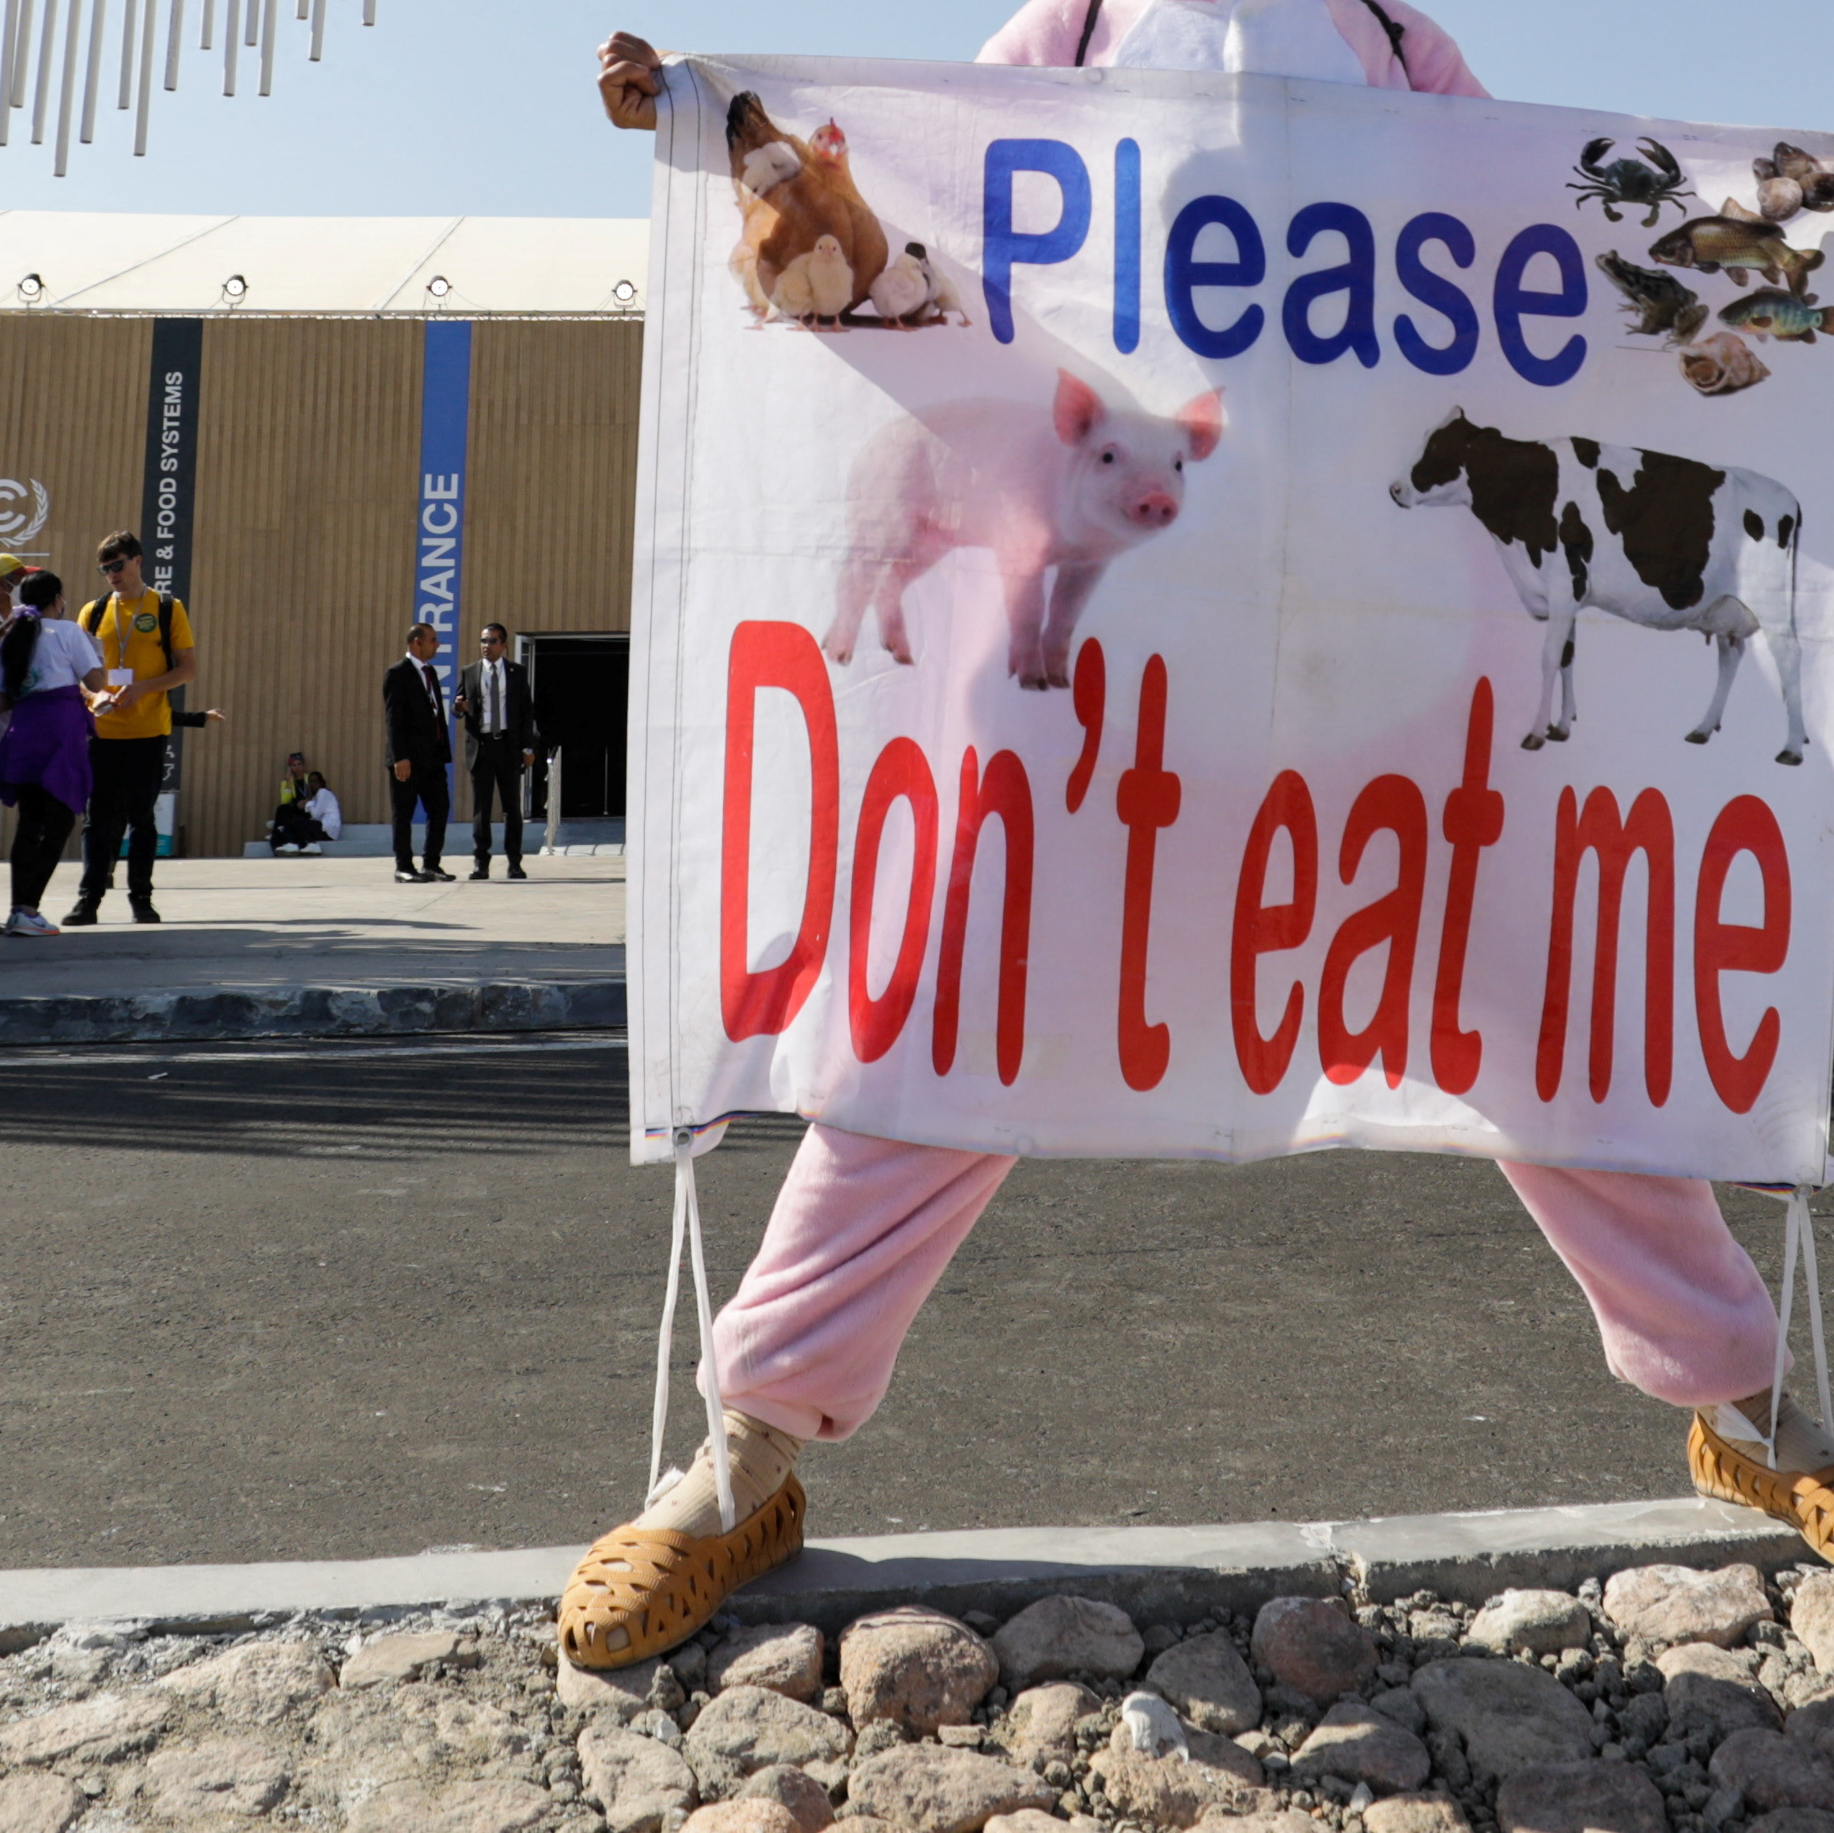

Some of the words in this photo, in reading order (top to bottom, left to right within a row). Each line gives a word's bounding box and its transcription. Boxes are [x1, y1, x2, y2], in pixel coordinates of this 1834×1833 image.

[981, 136, 1589, 386] Please
[160, 371, 183, 472] SYSTEMS
[155, 544, 174, 560] &
[156, 477, 177, 540] FOOD
[719, 619, 1181, 1093] Don't
[1229, 675, 1505, 1095] eat
[1535, 784, 1793, 1114] me
